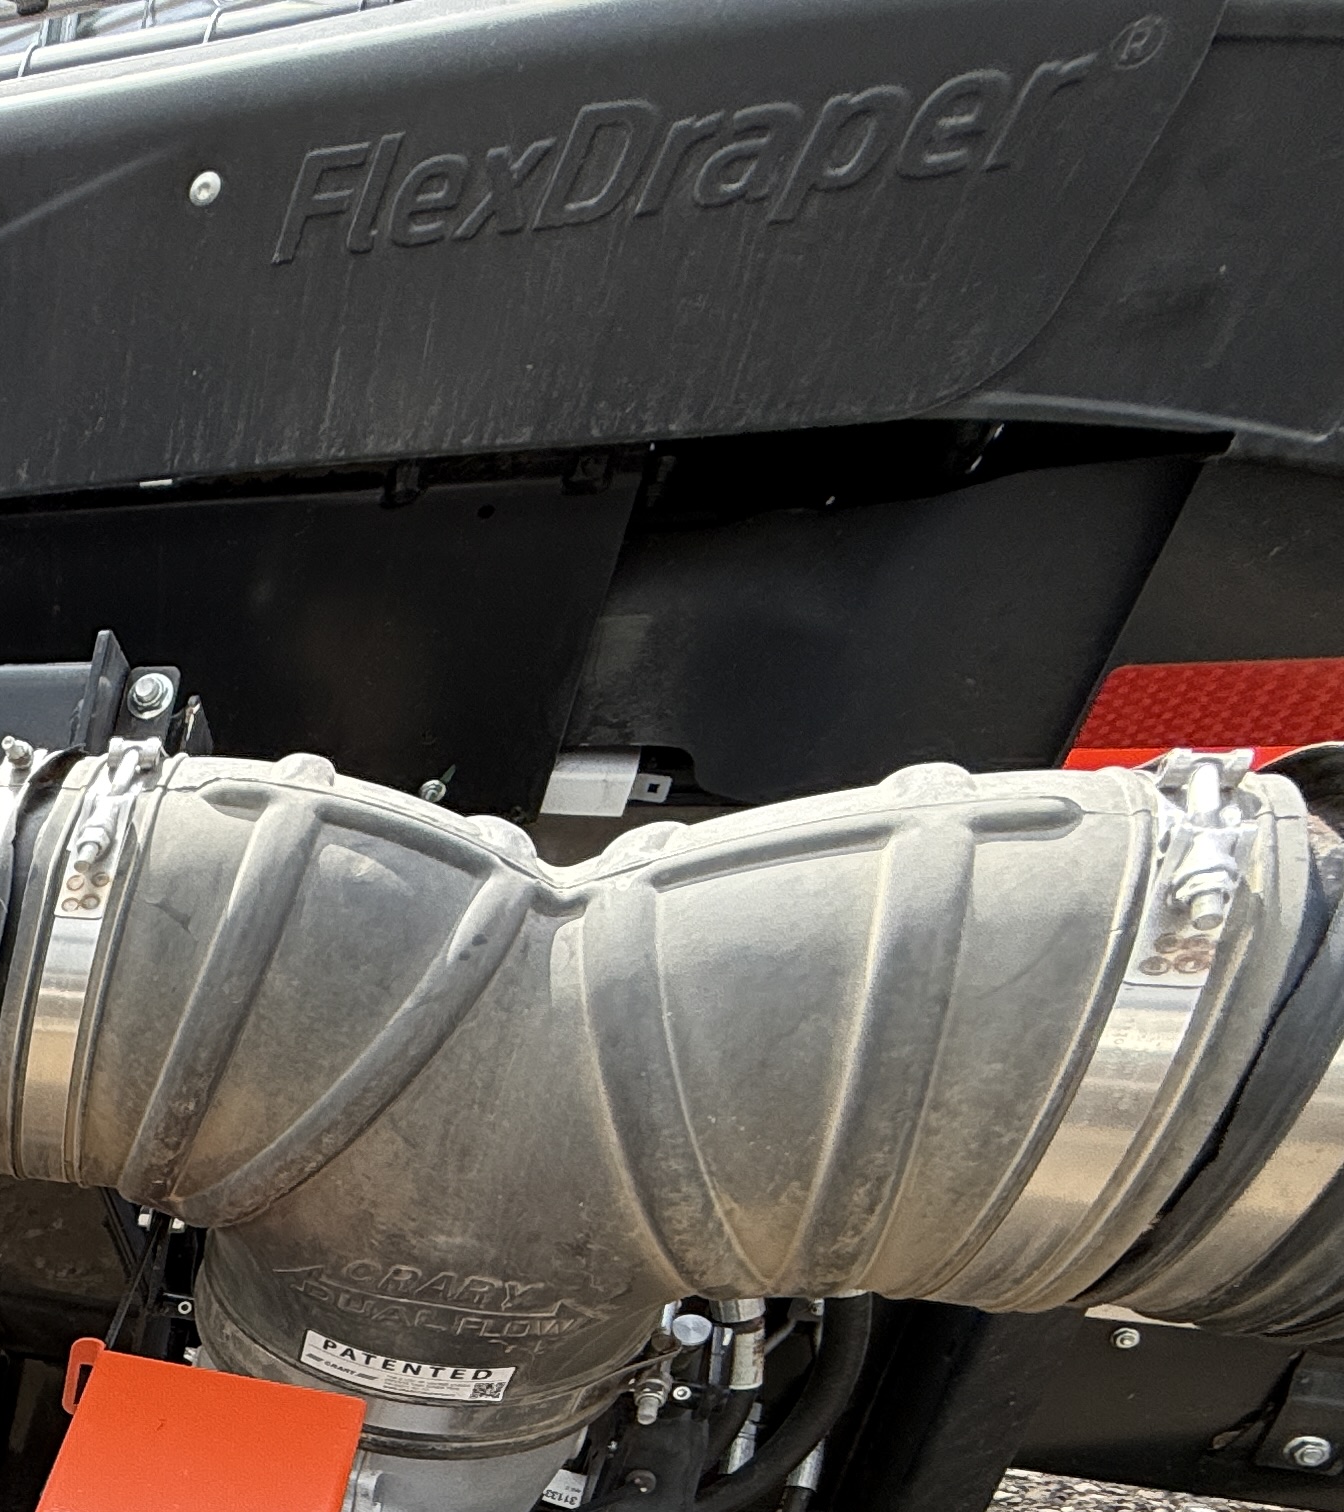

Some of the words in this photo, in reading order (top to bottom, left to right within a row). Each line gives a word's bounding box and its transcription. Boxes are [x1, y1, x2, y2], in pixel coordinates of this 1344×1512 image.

[290, 1279, 447, 1331] DUAL
[454, 1315, 576, 1338] FLOW
[342, 1258, 546, 1311] CRARY
[322, 1339, 493, 1381] PATENTED
